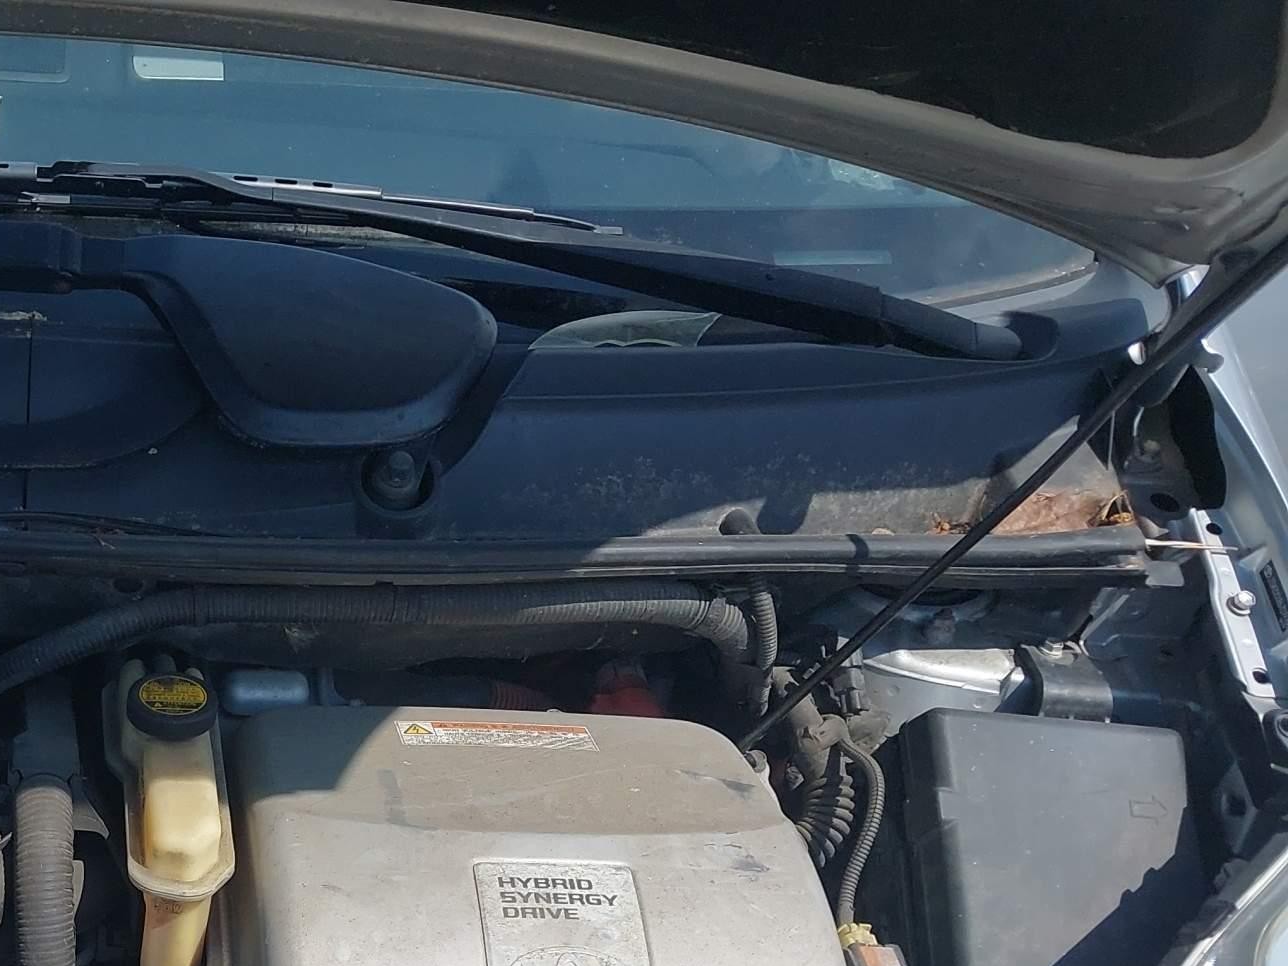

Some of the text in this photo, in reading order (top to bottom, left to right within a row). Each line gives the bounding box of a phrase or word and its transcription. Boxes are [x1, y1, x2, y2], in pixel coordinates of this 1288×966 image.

[497, 876, 593, 891] HYBRID
[499, 891, 618, 907] SYNERGY
[502, 906, 580, 920] DRIVE
